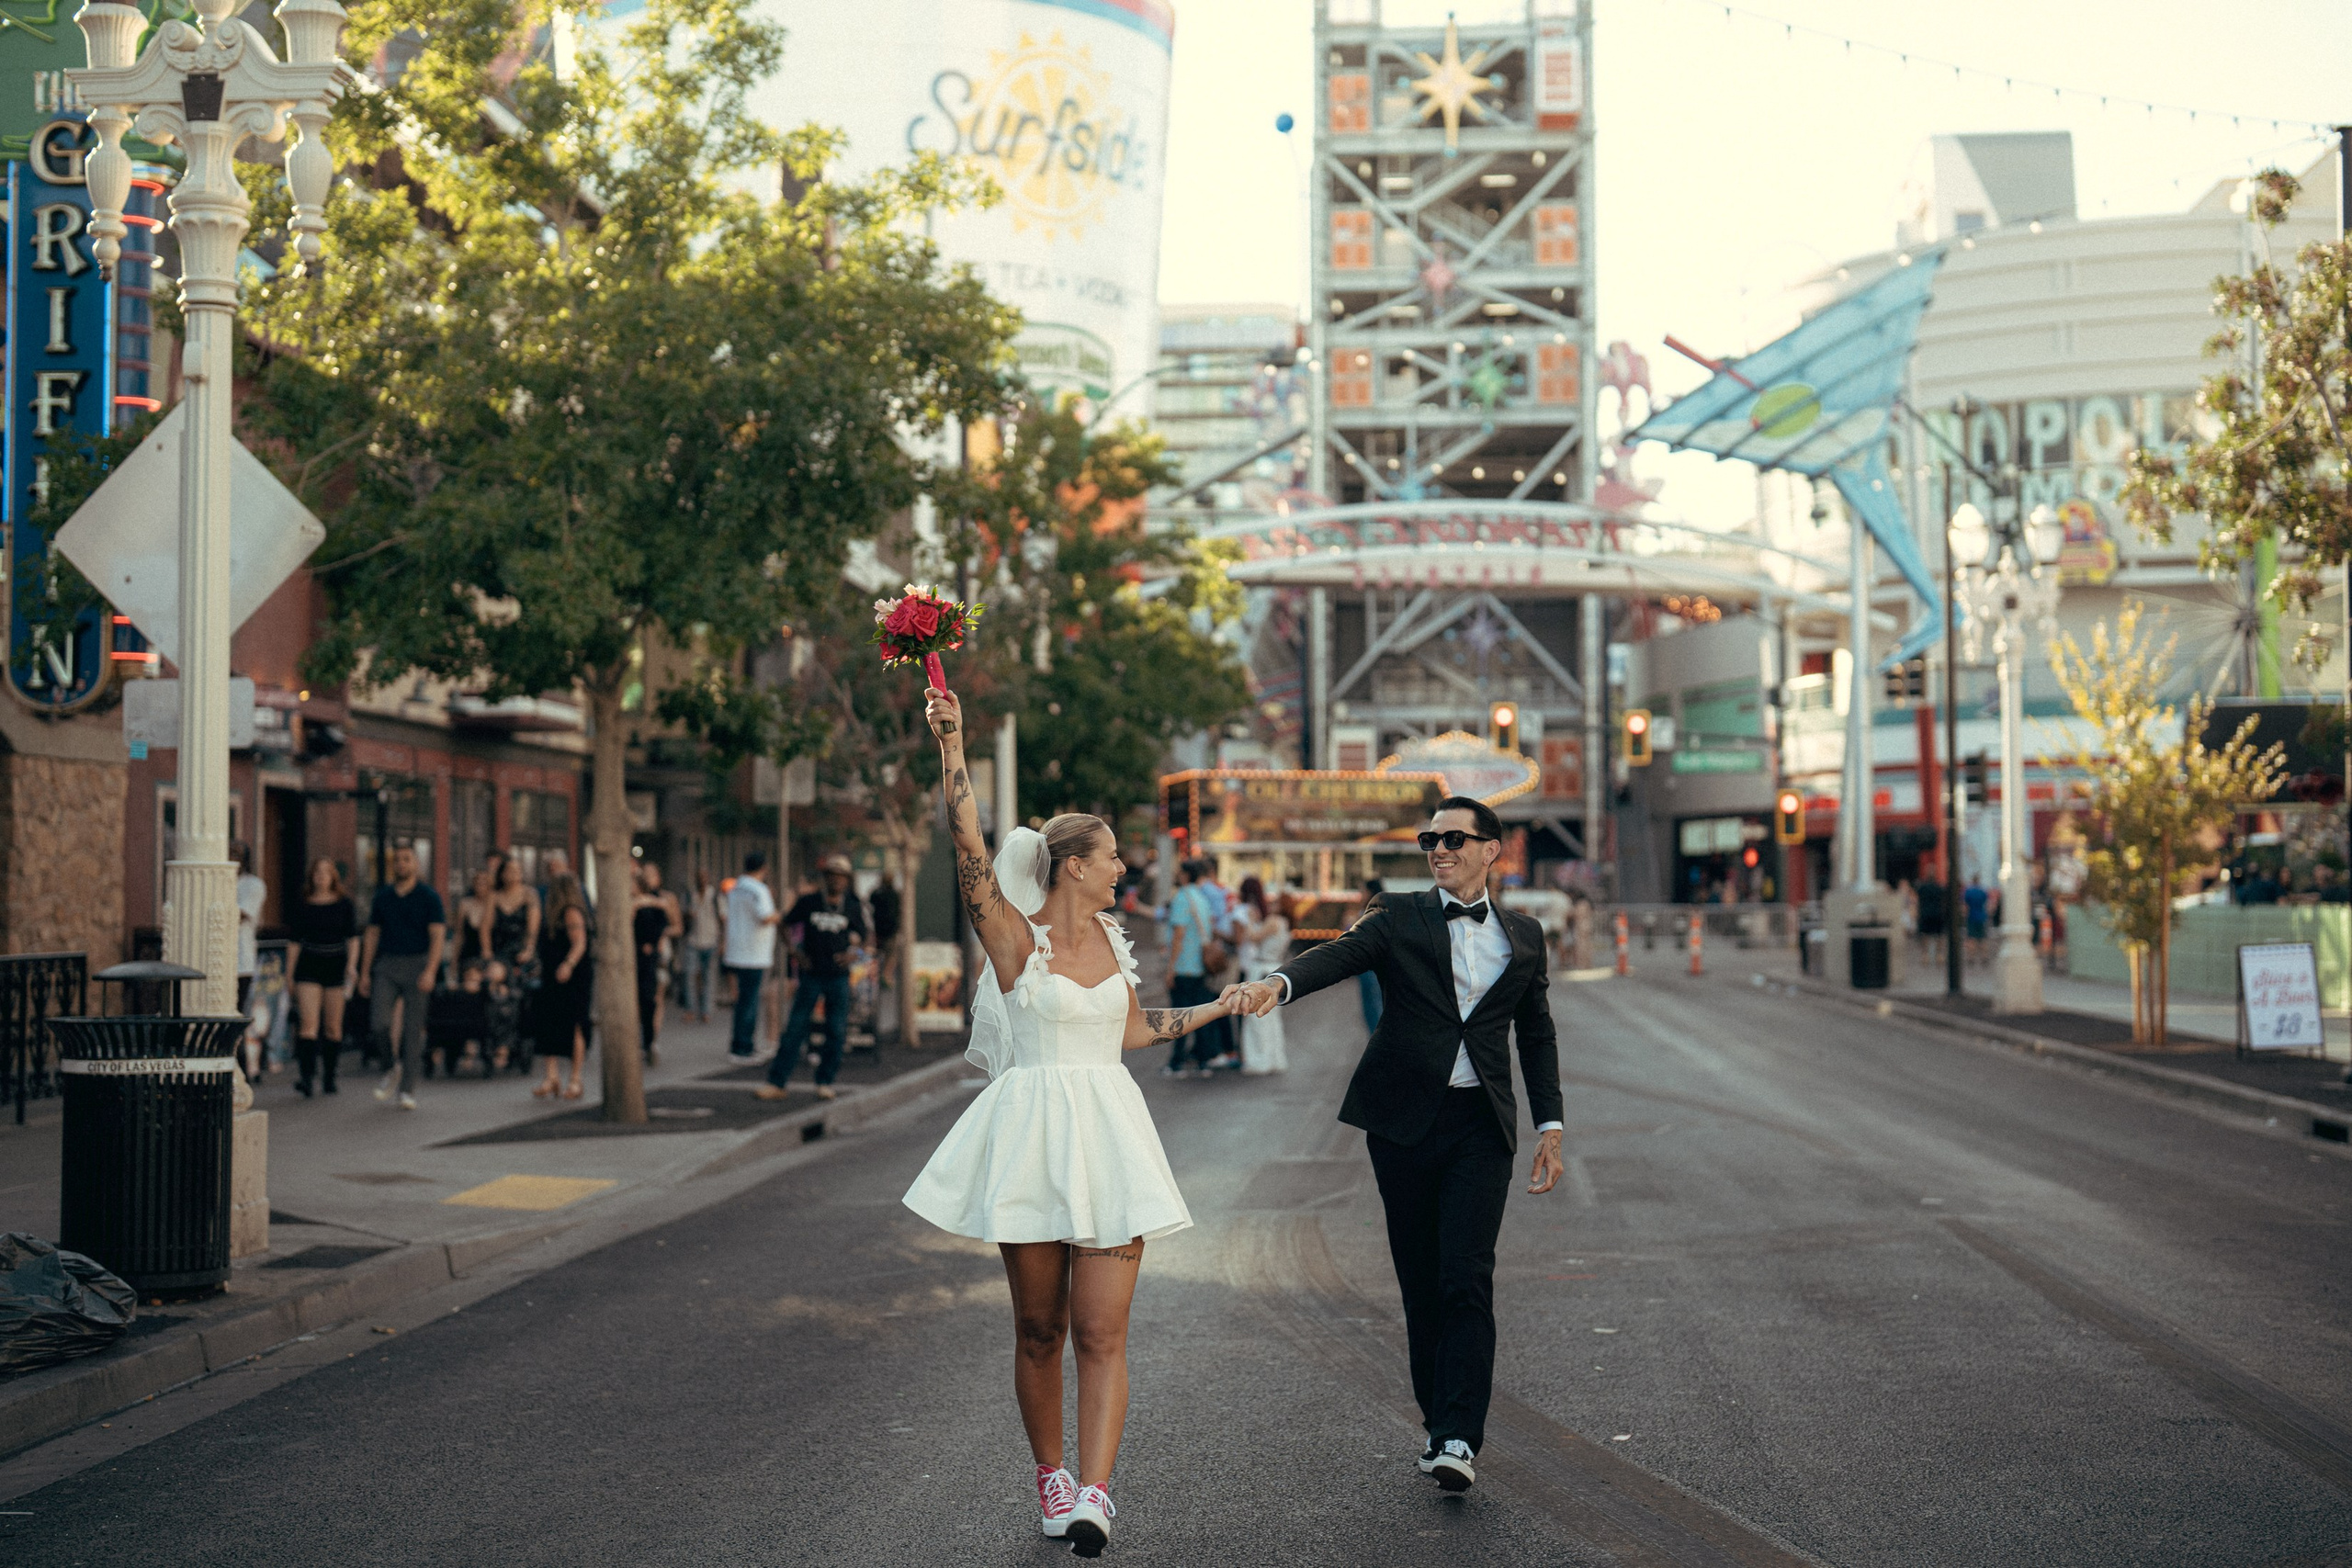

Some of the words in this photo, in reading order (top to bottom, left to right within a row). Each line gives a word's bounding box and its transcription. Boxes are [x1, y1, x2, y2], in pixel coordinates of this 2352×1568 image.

[87, 1062, 107, 1072] CITY
[110, 1062, 122, 1072] OF
[126, 1061, 147, 1071] LAS
[150, 1060, 186, 1071] VEGAS
